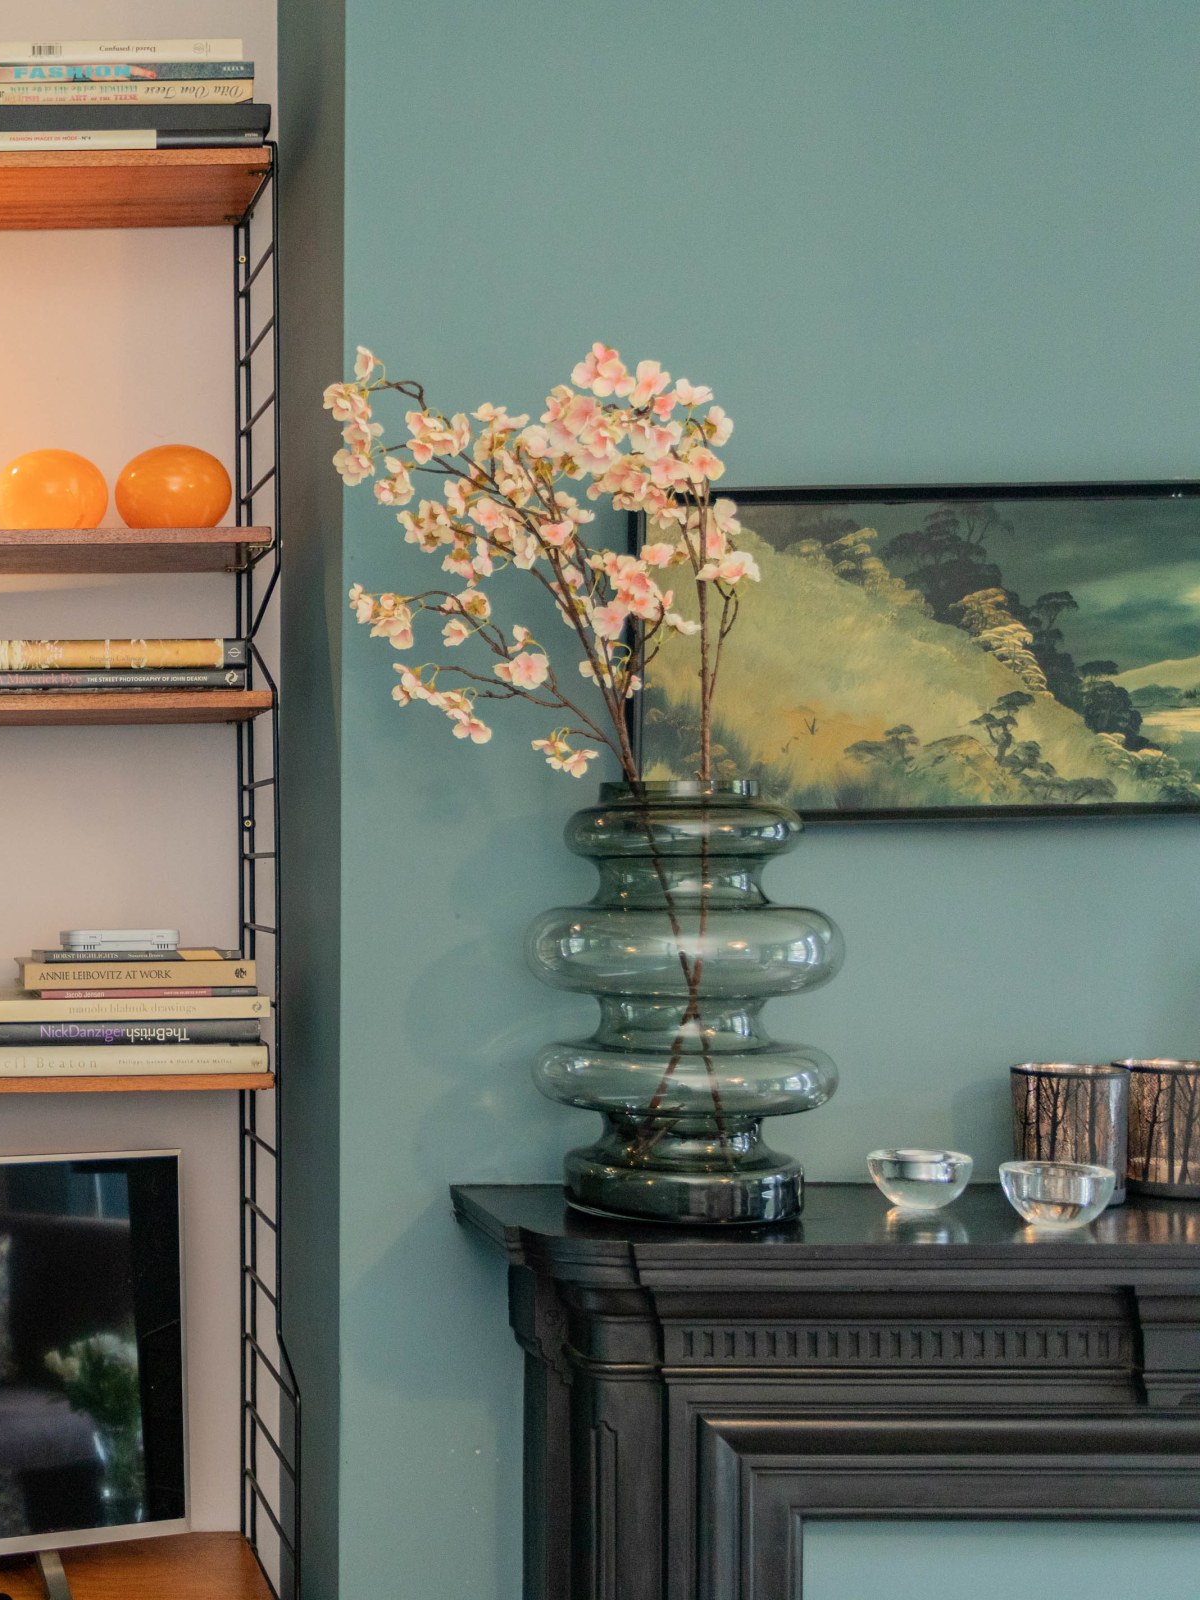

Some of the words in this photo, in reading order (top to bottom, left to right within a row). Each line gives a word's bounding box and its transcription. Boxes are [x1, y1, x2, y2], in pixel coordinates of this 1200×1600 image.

[13, 65, 131, 79] FASHION
[144, 86, 177, 99] Teese
[181, 85, 210, 98] Von
[214, 85, 243, 98] Dita
[7, 672, 58, 685] Maverick
[60, 672, 82, 687] Eye
[39, 971, 70, 981] ANNIE
[72, 970, 123, 981] LEIBOVITZ
[125, 970, 140, 980] AT
[141, 969, 172, 979] WORK
[64, 990, 83, 999] Jacob
[84, 990, 105, 999] Jensen
[68, 1003, 108, 1014] manolo
[109, 1002, 148, 1014] blahnik
[150, 1002, 197, 1015] drawings
[40, 1024, 125, 1042] NickDanziger
[36, 1056, 98, 1069] Beaton
